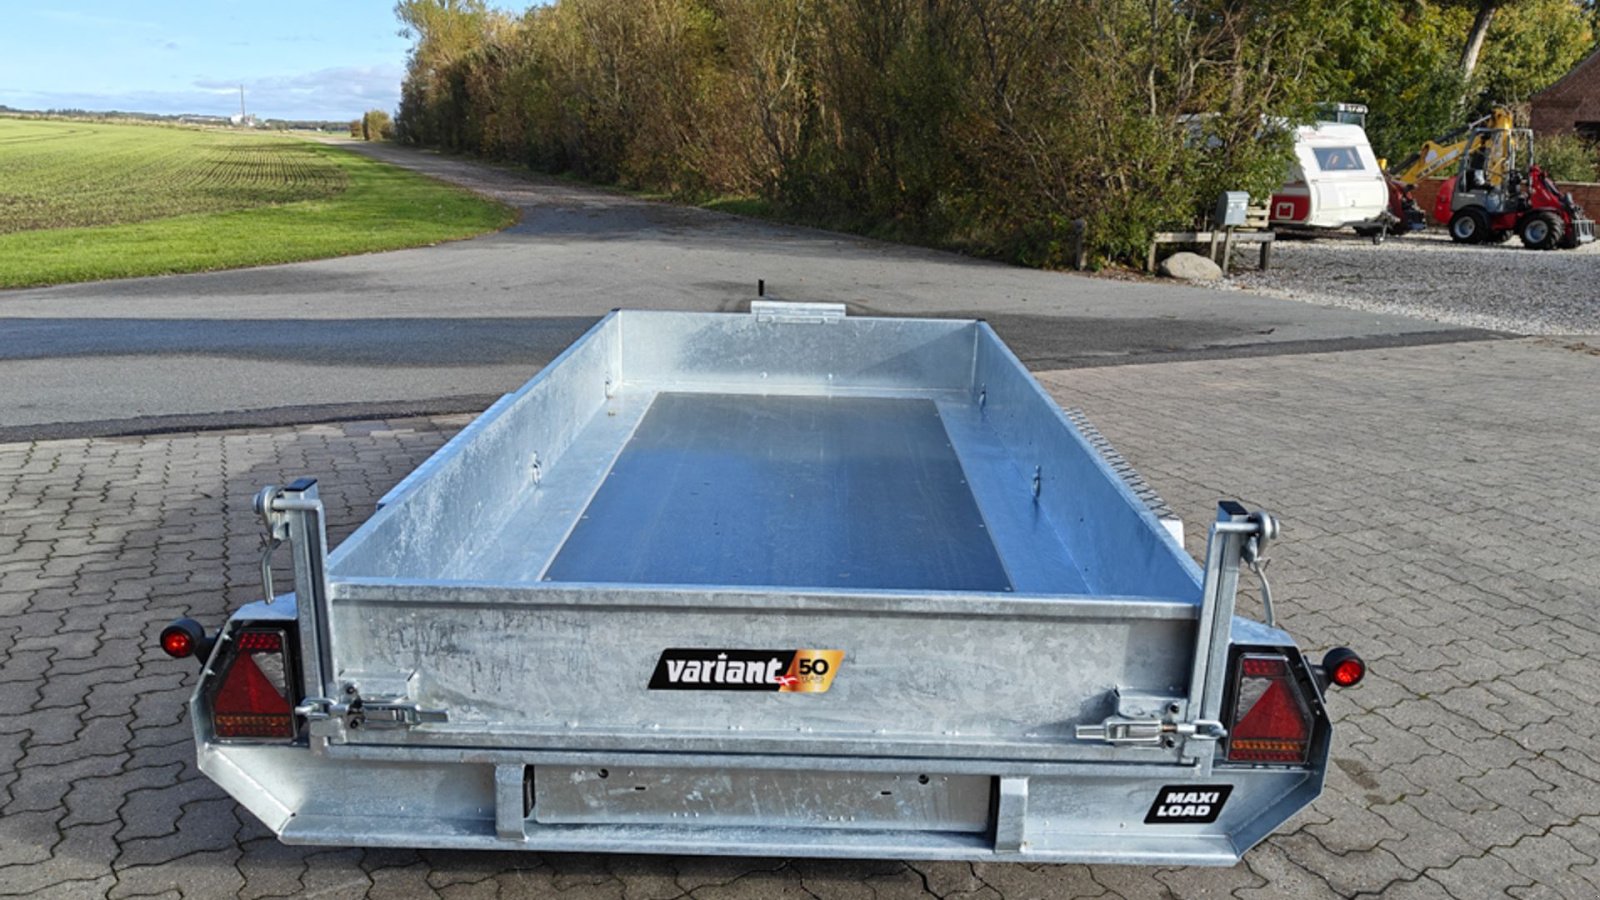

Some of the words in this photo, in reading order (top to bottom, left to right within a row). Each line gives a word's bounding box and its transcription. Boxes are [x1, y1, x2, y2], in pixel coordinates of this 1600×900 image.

[666, 653, 782, 684] variant
[799, 659, 829, 675] 50
[1165, 792, 1220, 804] MAXI
[1156, 805, 1211, 817] LOAD
